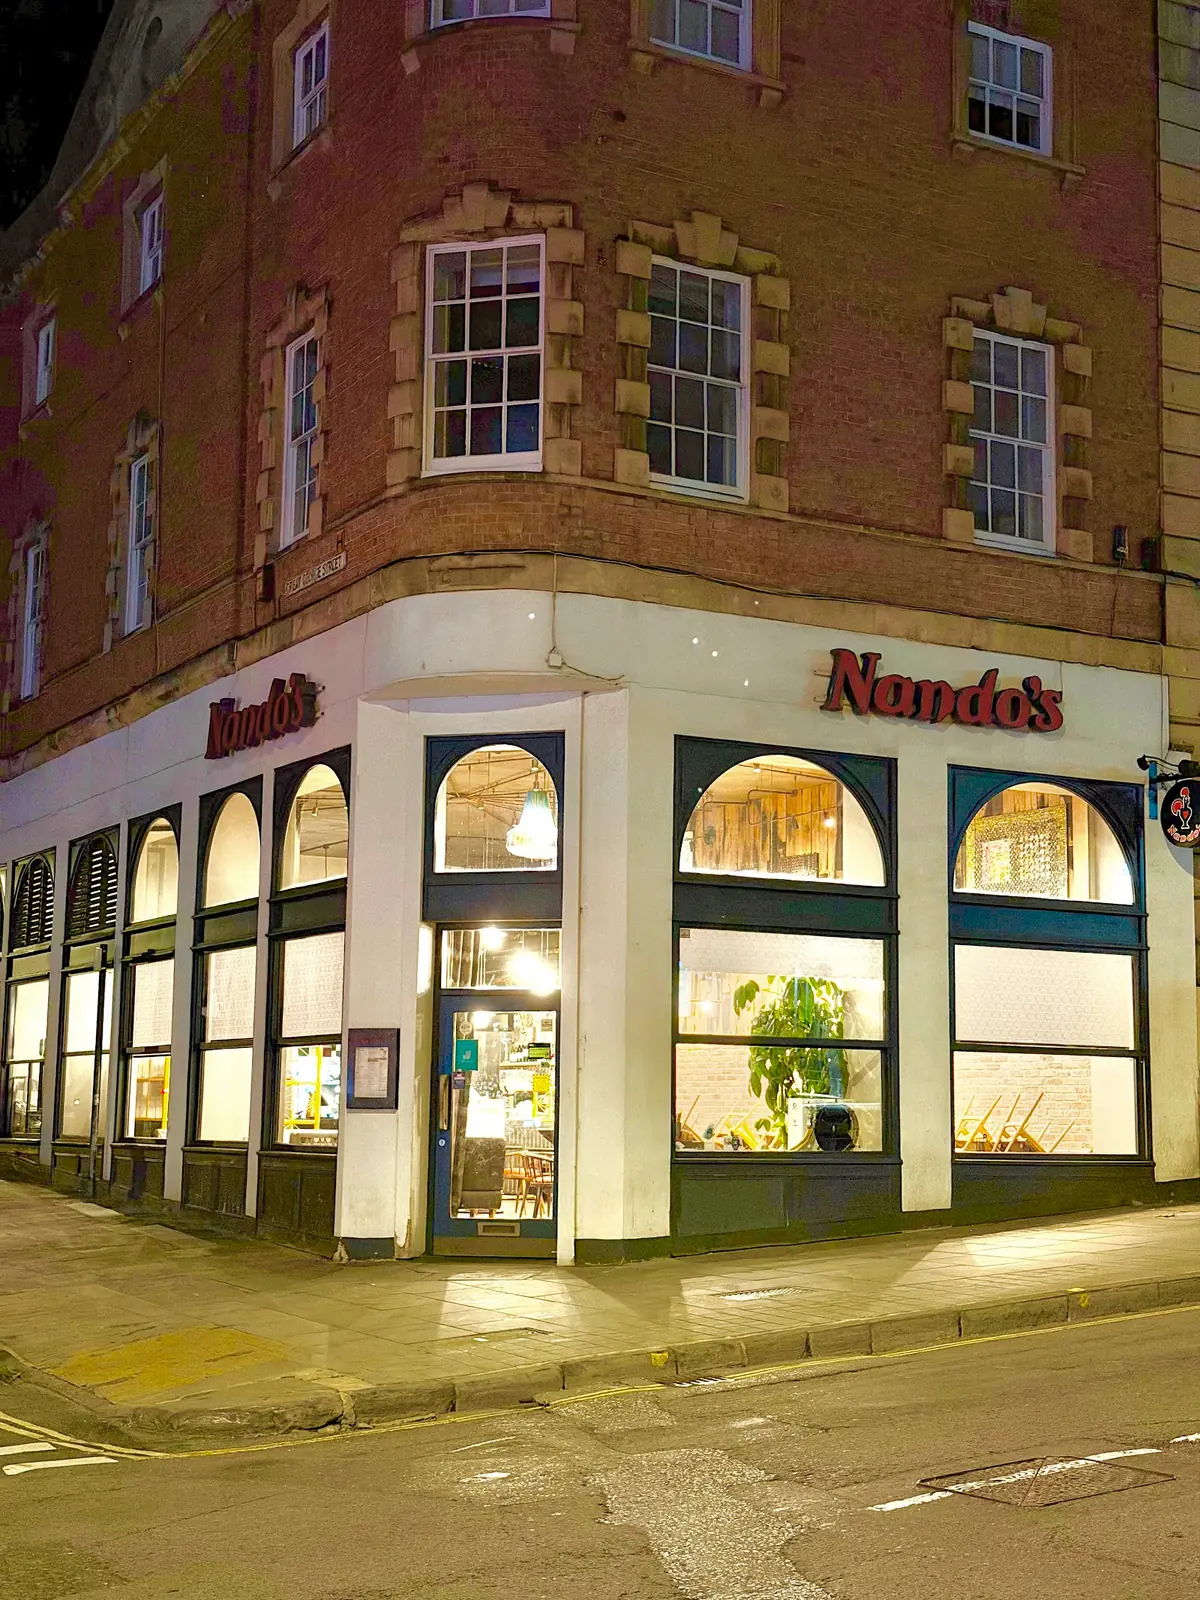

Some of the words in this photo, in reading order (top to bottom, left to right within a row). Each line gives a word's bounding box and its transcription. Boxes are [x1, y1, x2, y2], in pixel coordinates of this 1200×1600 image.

[205, 673, 316, 759] Nando's
[820, 648, 1064, 732] Nando's
[1166, 822, 1200, 843] Nando'
